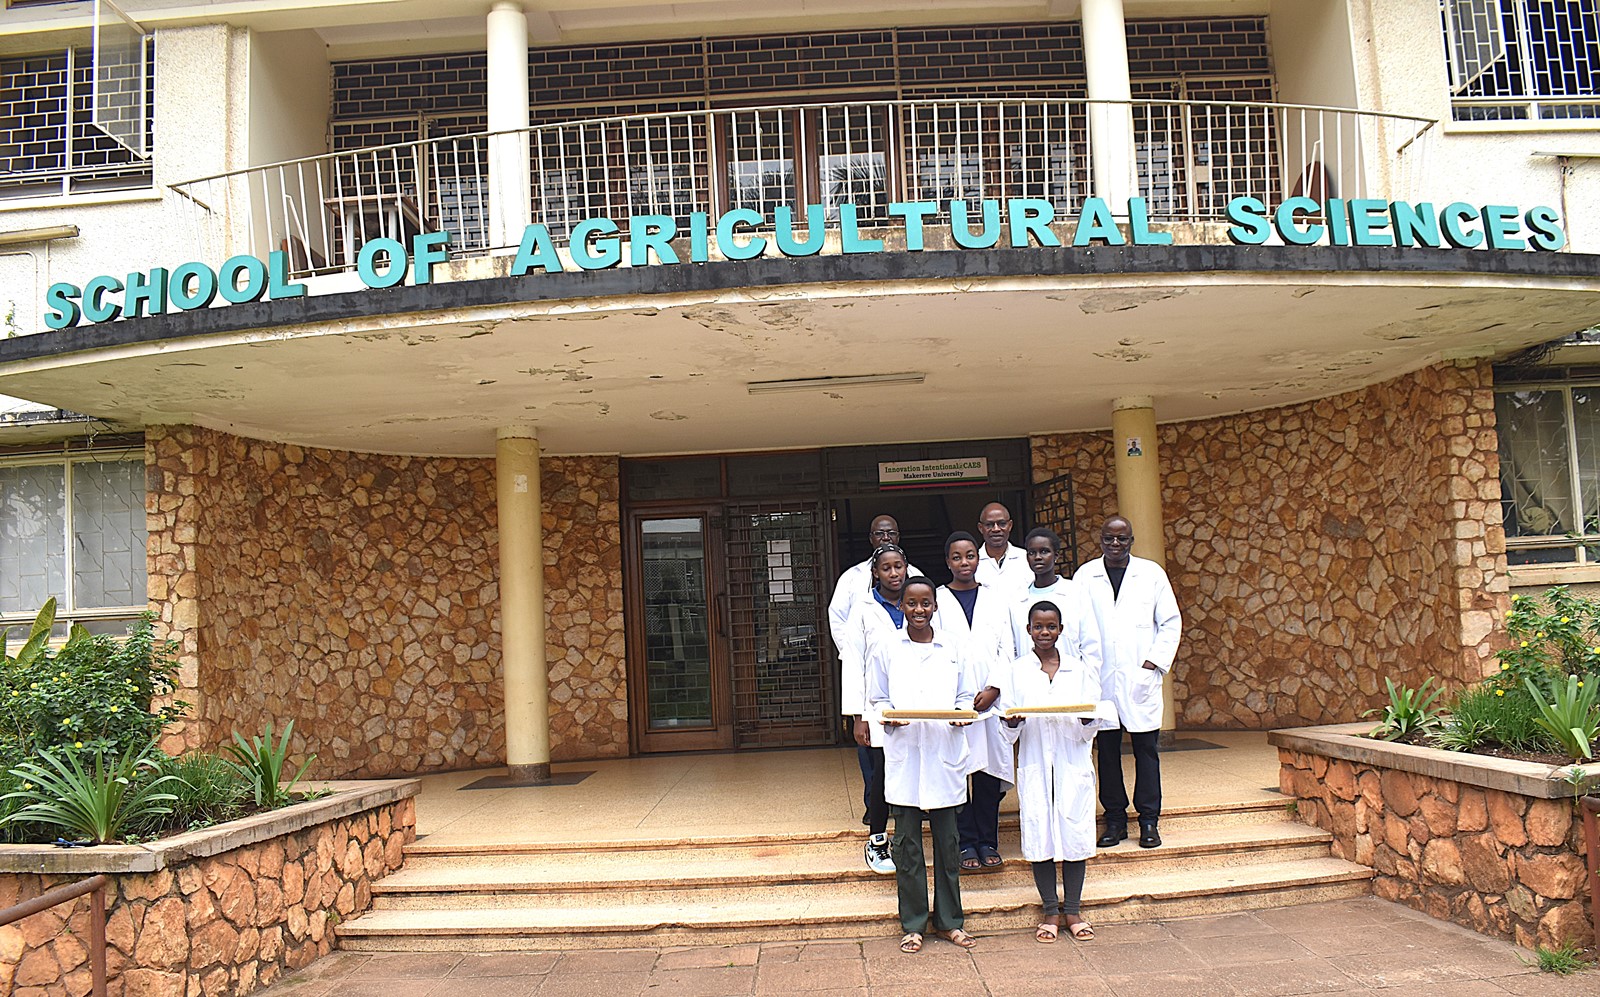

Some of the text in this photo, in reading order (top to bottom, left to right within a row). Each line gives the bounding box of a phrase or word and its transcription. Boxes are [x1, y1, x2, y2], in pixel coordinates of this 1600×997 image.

[44, 196, 1565, 329] SCHOOL OF AGRICULTURAL SCIENCES
[885, 464, 920, 473] Innovation
[903, 470, 964, 480] Makerere University
